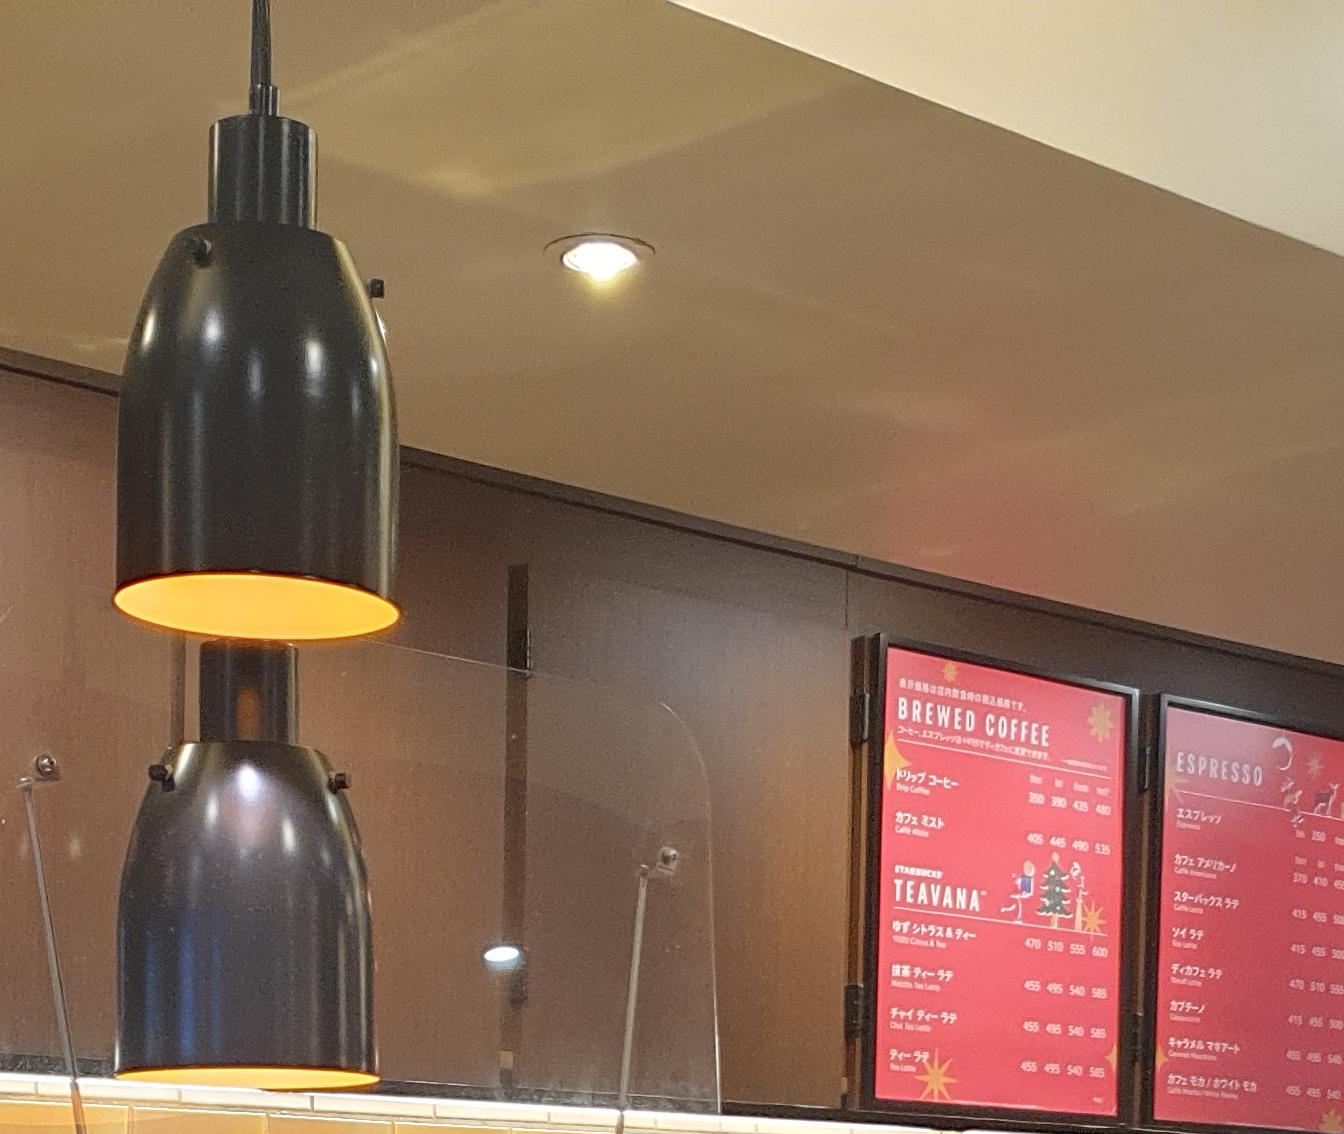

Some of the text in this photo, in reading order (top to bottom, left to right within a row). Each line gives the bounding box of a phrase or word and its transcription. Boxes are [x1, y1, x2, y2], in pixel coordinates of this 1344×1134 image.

[898, 696, 1050, 747] BREWED COFFEE
[1176, 752, 1263, 786] ESPRESSO
[929, 775, 959, 789] コーヒー
[895, 811, 945, 829] カフェ ミスト
[1176, 808, 1221, 824] エスプレッソ
[1174, 853, 1194, 866] カフェ
[1174, 891, 1223, 908] スターバックス
[913, 967, 935, 979] ティー
[937, 970, 953, 982] ラテ
[889, 1008, 957, 1024] チャイ ティー ラテ
[1168, 1036, 1205, 1050] キャラメル
[890, 1049, 911, 1061] ティー
[1167, 1073, 1188, 1086] カフェ
